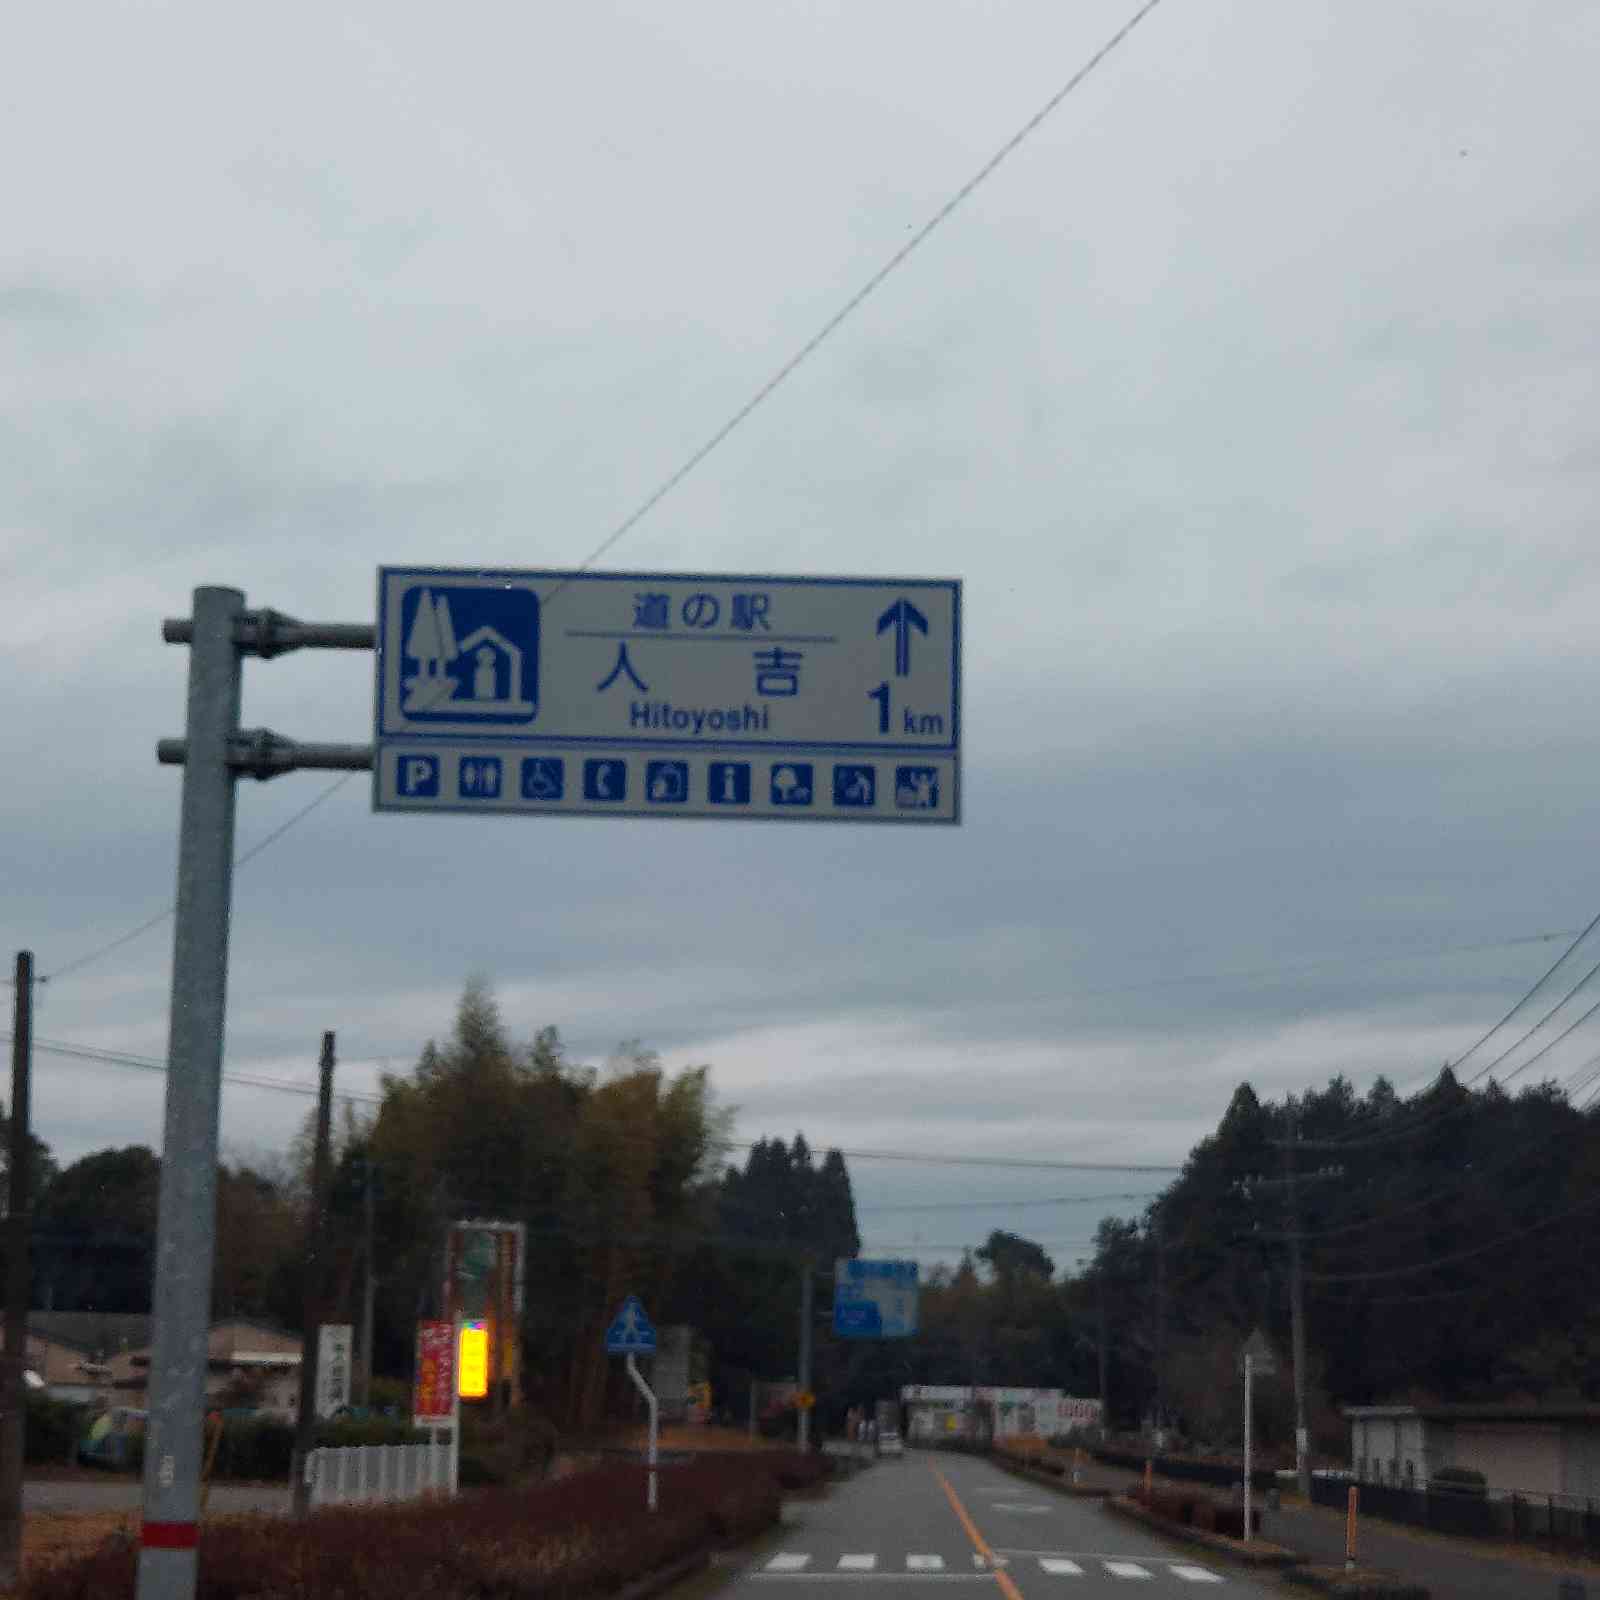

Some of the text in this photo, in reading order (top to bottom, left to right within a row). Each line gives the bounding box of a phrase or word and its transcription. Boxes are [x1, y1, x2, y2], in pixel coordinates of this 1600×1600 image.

[634, 592, 771, 631] 道の駅
[597, 640, 803, 697] 人吉
[631, 702, 769, 735] Hitoyoshi
[868, 681, 944, 735] 1 km
